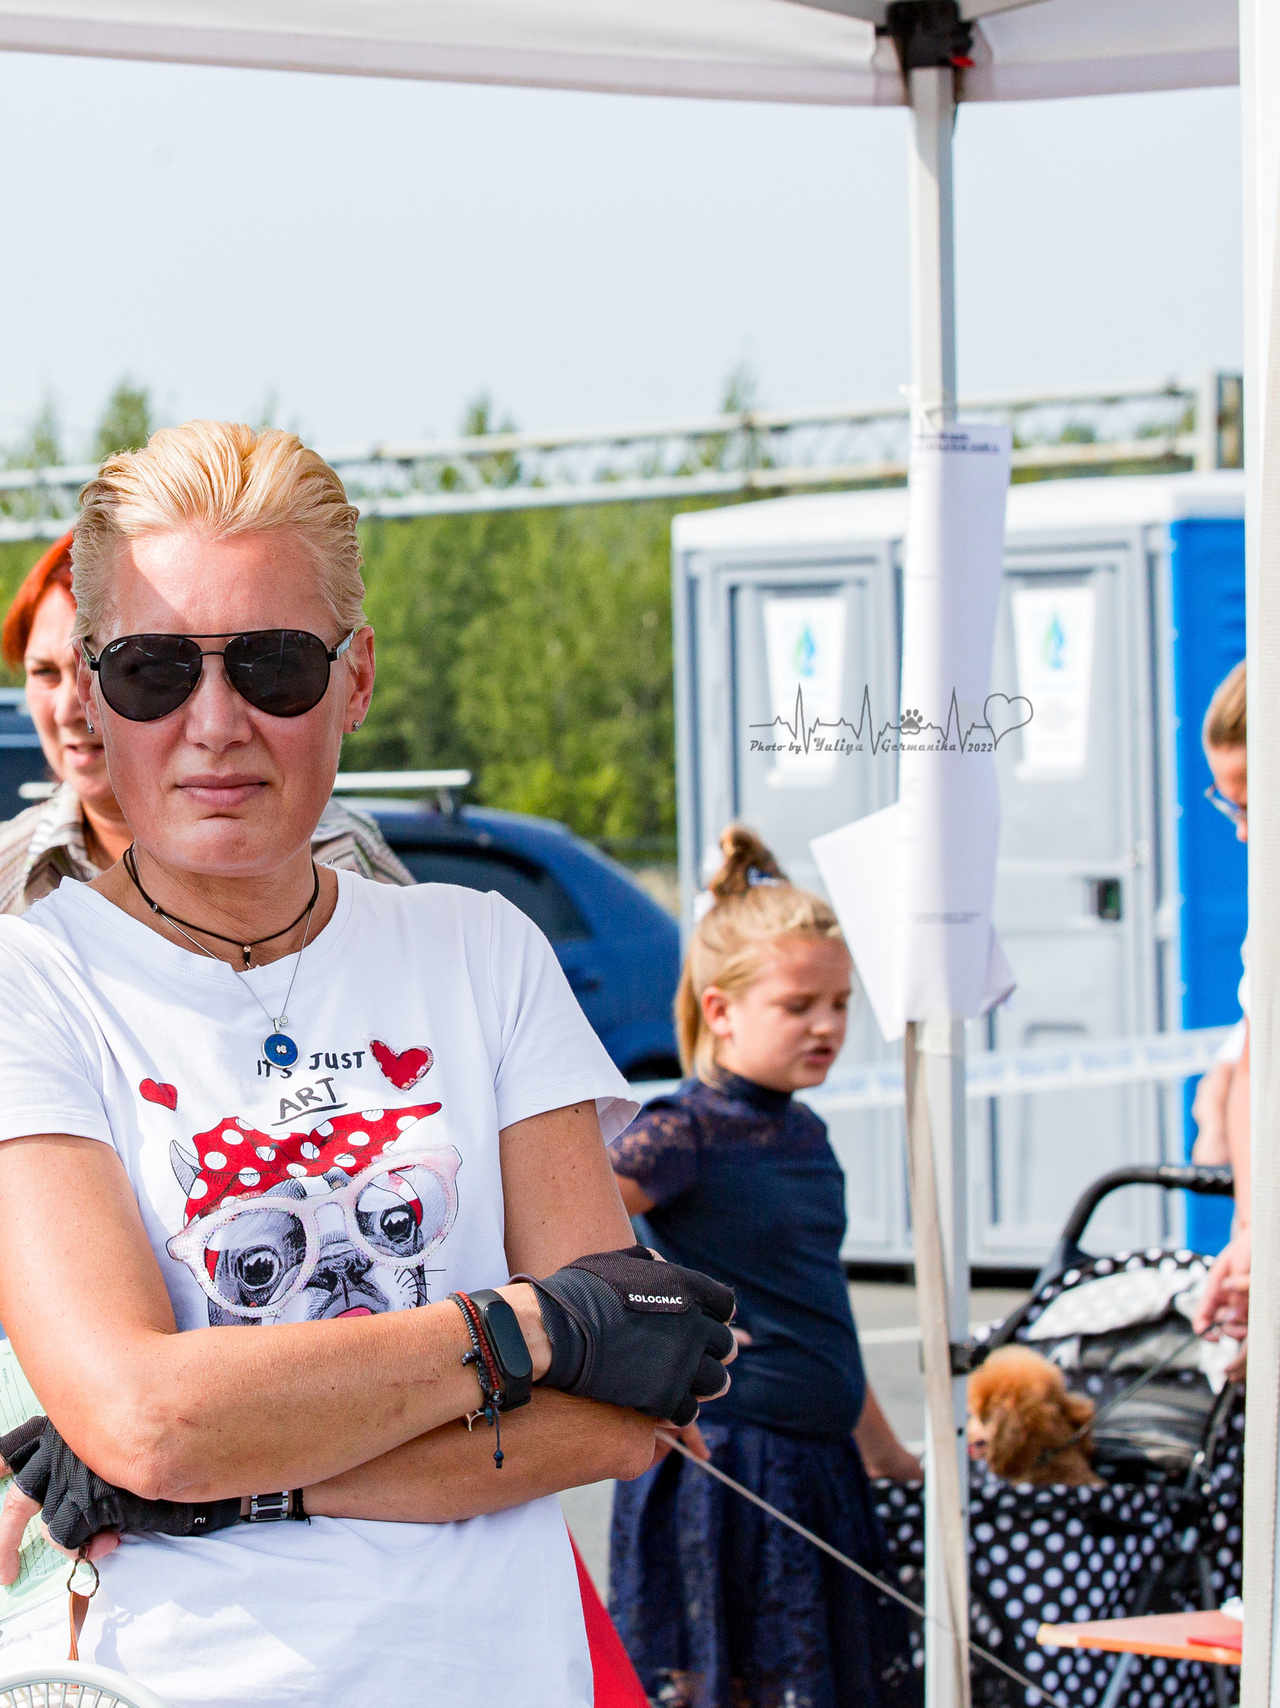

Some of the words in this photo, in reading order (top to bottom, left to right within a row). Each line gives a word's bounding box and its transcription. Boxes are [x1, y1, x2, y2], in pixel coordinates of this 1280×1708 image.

[257, 1059, 293, 1079] ITS
[308, 1051, 365, 1070] JUST
[279, 1077, 336, 1120] ART
[628, 1293, 683, 1305] SOLOGNAC
